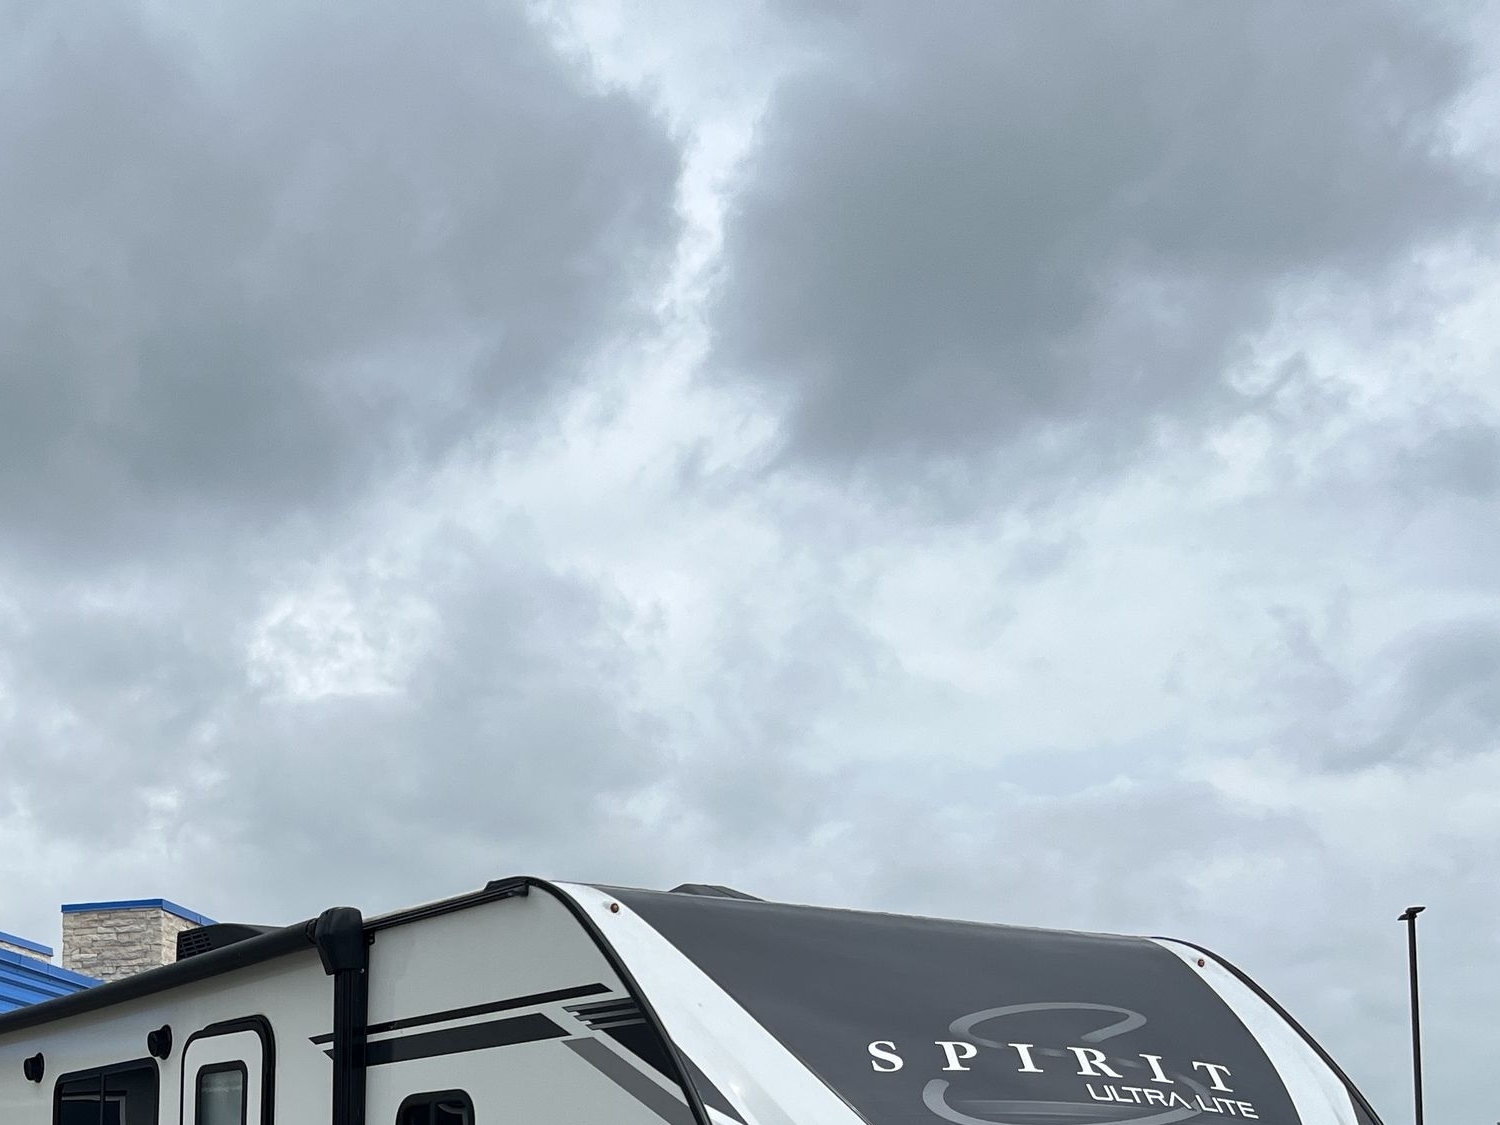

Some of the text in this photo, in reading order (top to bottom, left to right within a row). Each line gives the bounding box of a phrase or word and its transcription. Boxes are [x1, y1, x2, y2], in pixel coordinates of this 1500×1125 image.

[867, 1040, 1234, 1092] SPIRIT
[1086, 1083, 1260, 1120] ULTRA LITE
